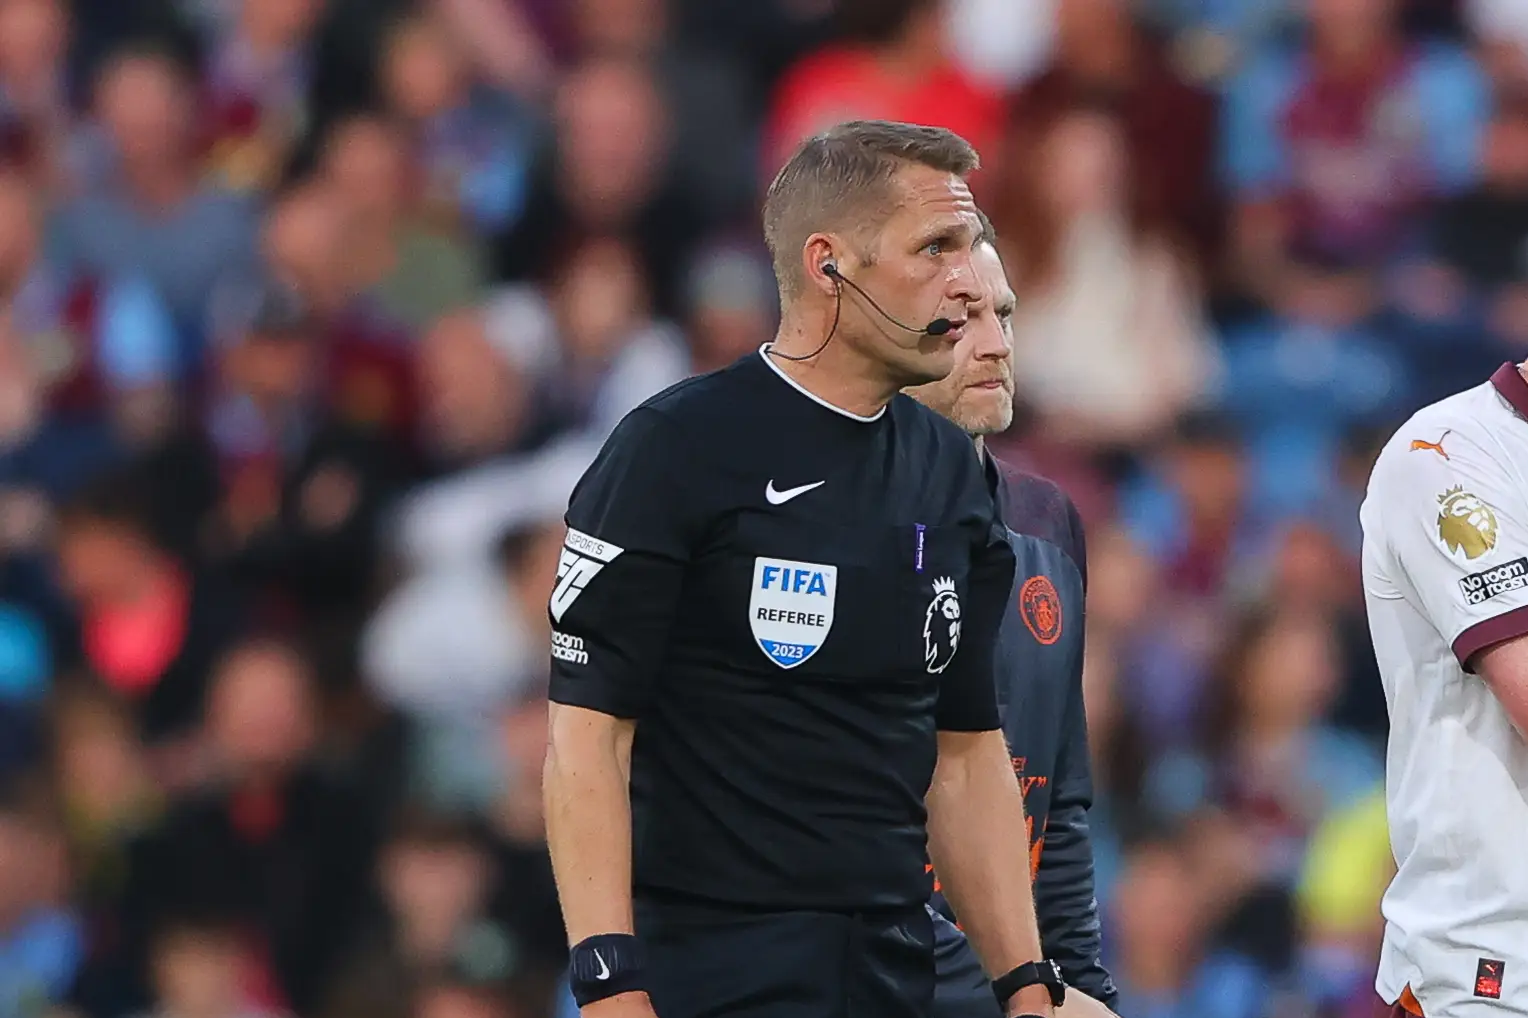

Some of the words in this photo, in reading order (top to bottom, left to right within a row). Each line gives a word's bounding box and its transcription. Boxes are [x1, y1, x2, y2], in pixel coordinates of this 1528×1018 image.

[761, 565, 827, 596] FIFA
[1459, 575, 1481, 594] No
[1483, 561, 1524, 584] room
[1464, 586, 1486, 604] for
[757, 607, 825, 627] REFEREE
[772, 644, 804, 659] 2023
